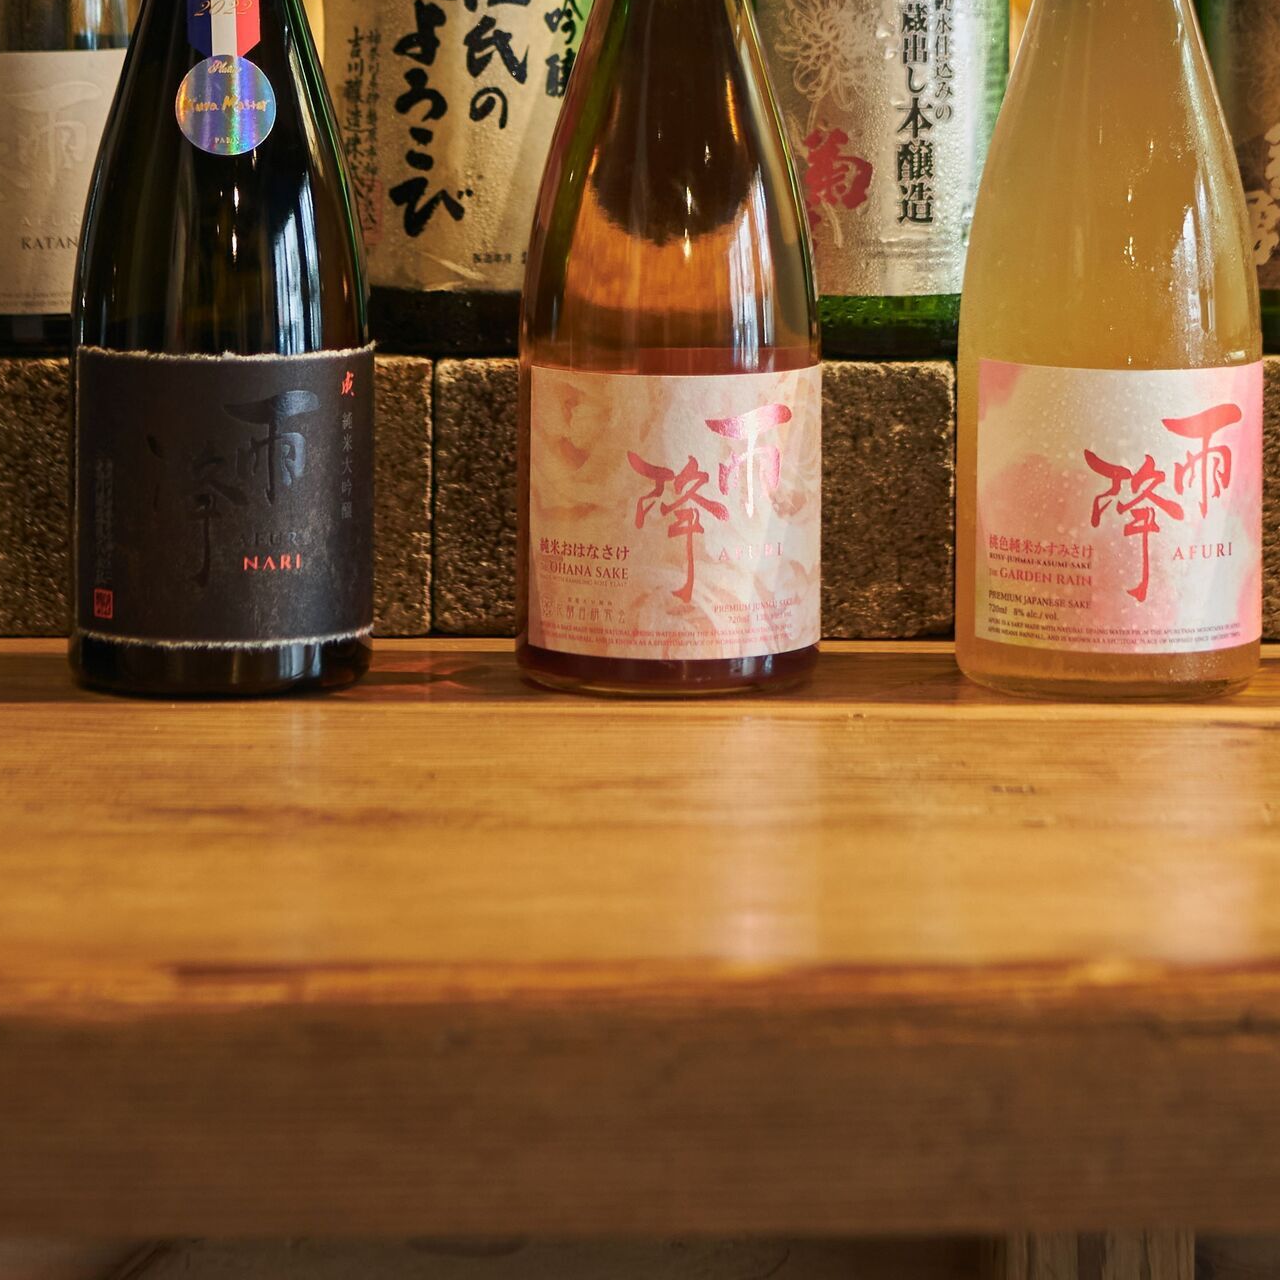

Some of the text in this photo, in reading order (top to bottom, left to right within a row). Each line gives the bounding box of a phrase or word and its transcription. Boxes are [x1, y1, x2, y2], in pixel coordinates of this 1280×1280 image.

[194, 0, 253, 17] 2022
[21, 236, 79, 251] KATAN
[540, 537, 629, 561] 純米おはなさけ
[719, 542, 781, 561] AFURI
[989, 535, 1093, 559] 桃色純米かすみさけ
[1173, 542, 1232, 560] AFURI
[243, 554, 302, 571] NARI
[550, 561, 591, 577] OHANA
[596, 566, 628, 580] SAKE
[1000, 567, 1052, 583] GARDEN
[1056, 574, 1092, 586] RAIN
[989, 590, 1092, 609] PREMIUM JAPANESE SAKE
[989, 603, 1007, 614] 720ml
